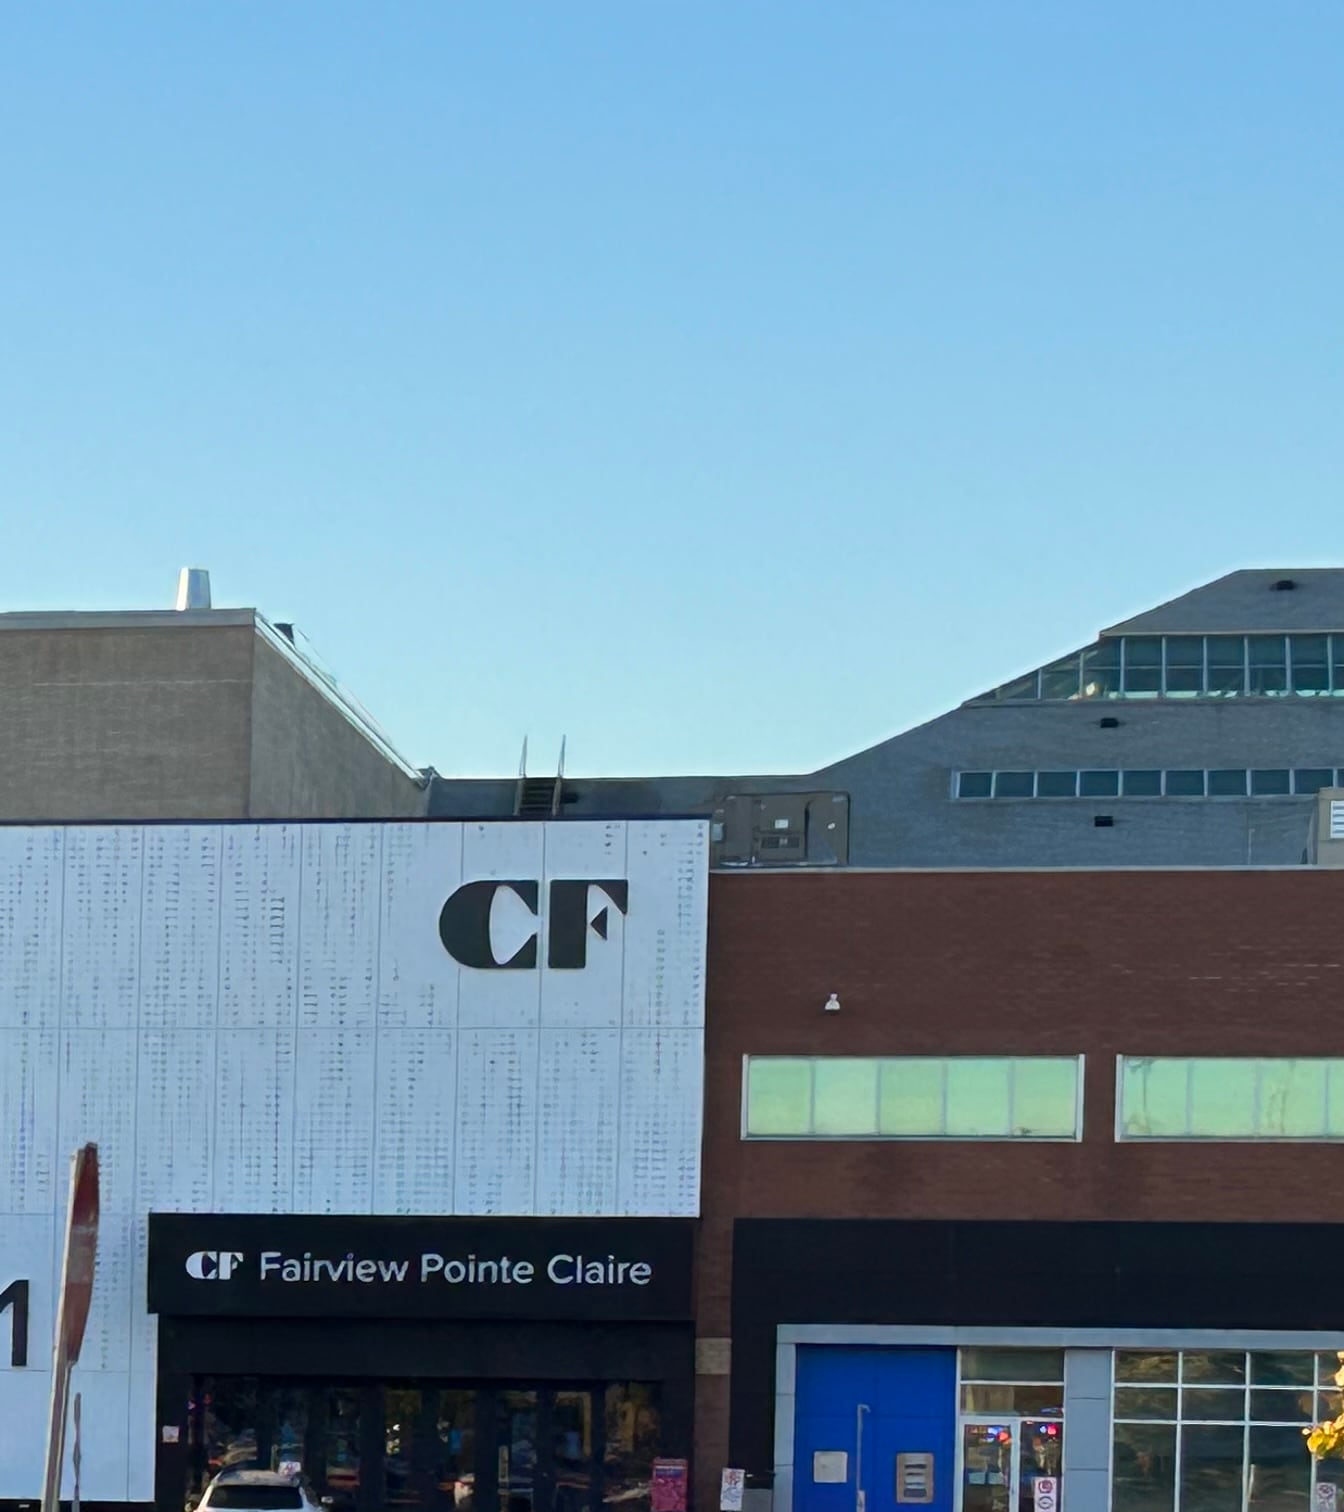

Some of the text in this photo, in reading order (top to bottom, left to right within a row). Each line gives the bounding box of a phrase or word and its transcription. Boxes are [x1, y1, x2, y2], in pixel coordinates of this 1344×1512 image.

[438, 879, 628, 969] CF
[185, 1250, 653, 1285] CF Fairview Pointe Claire
